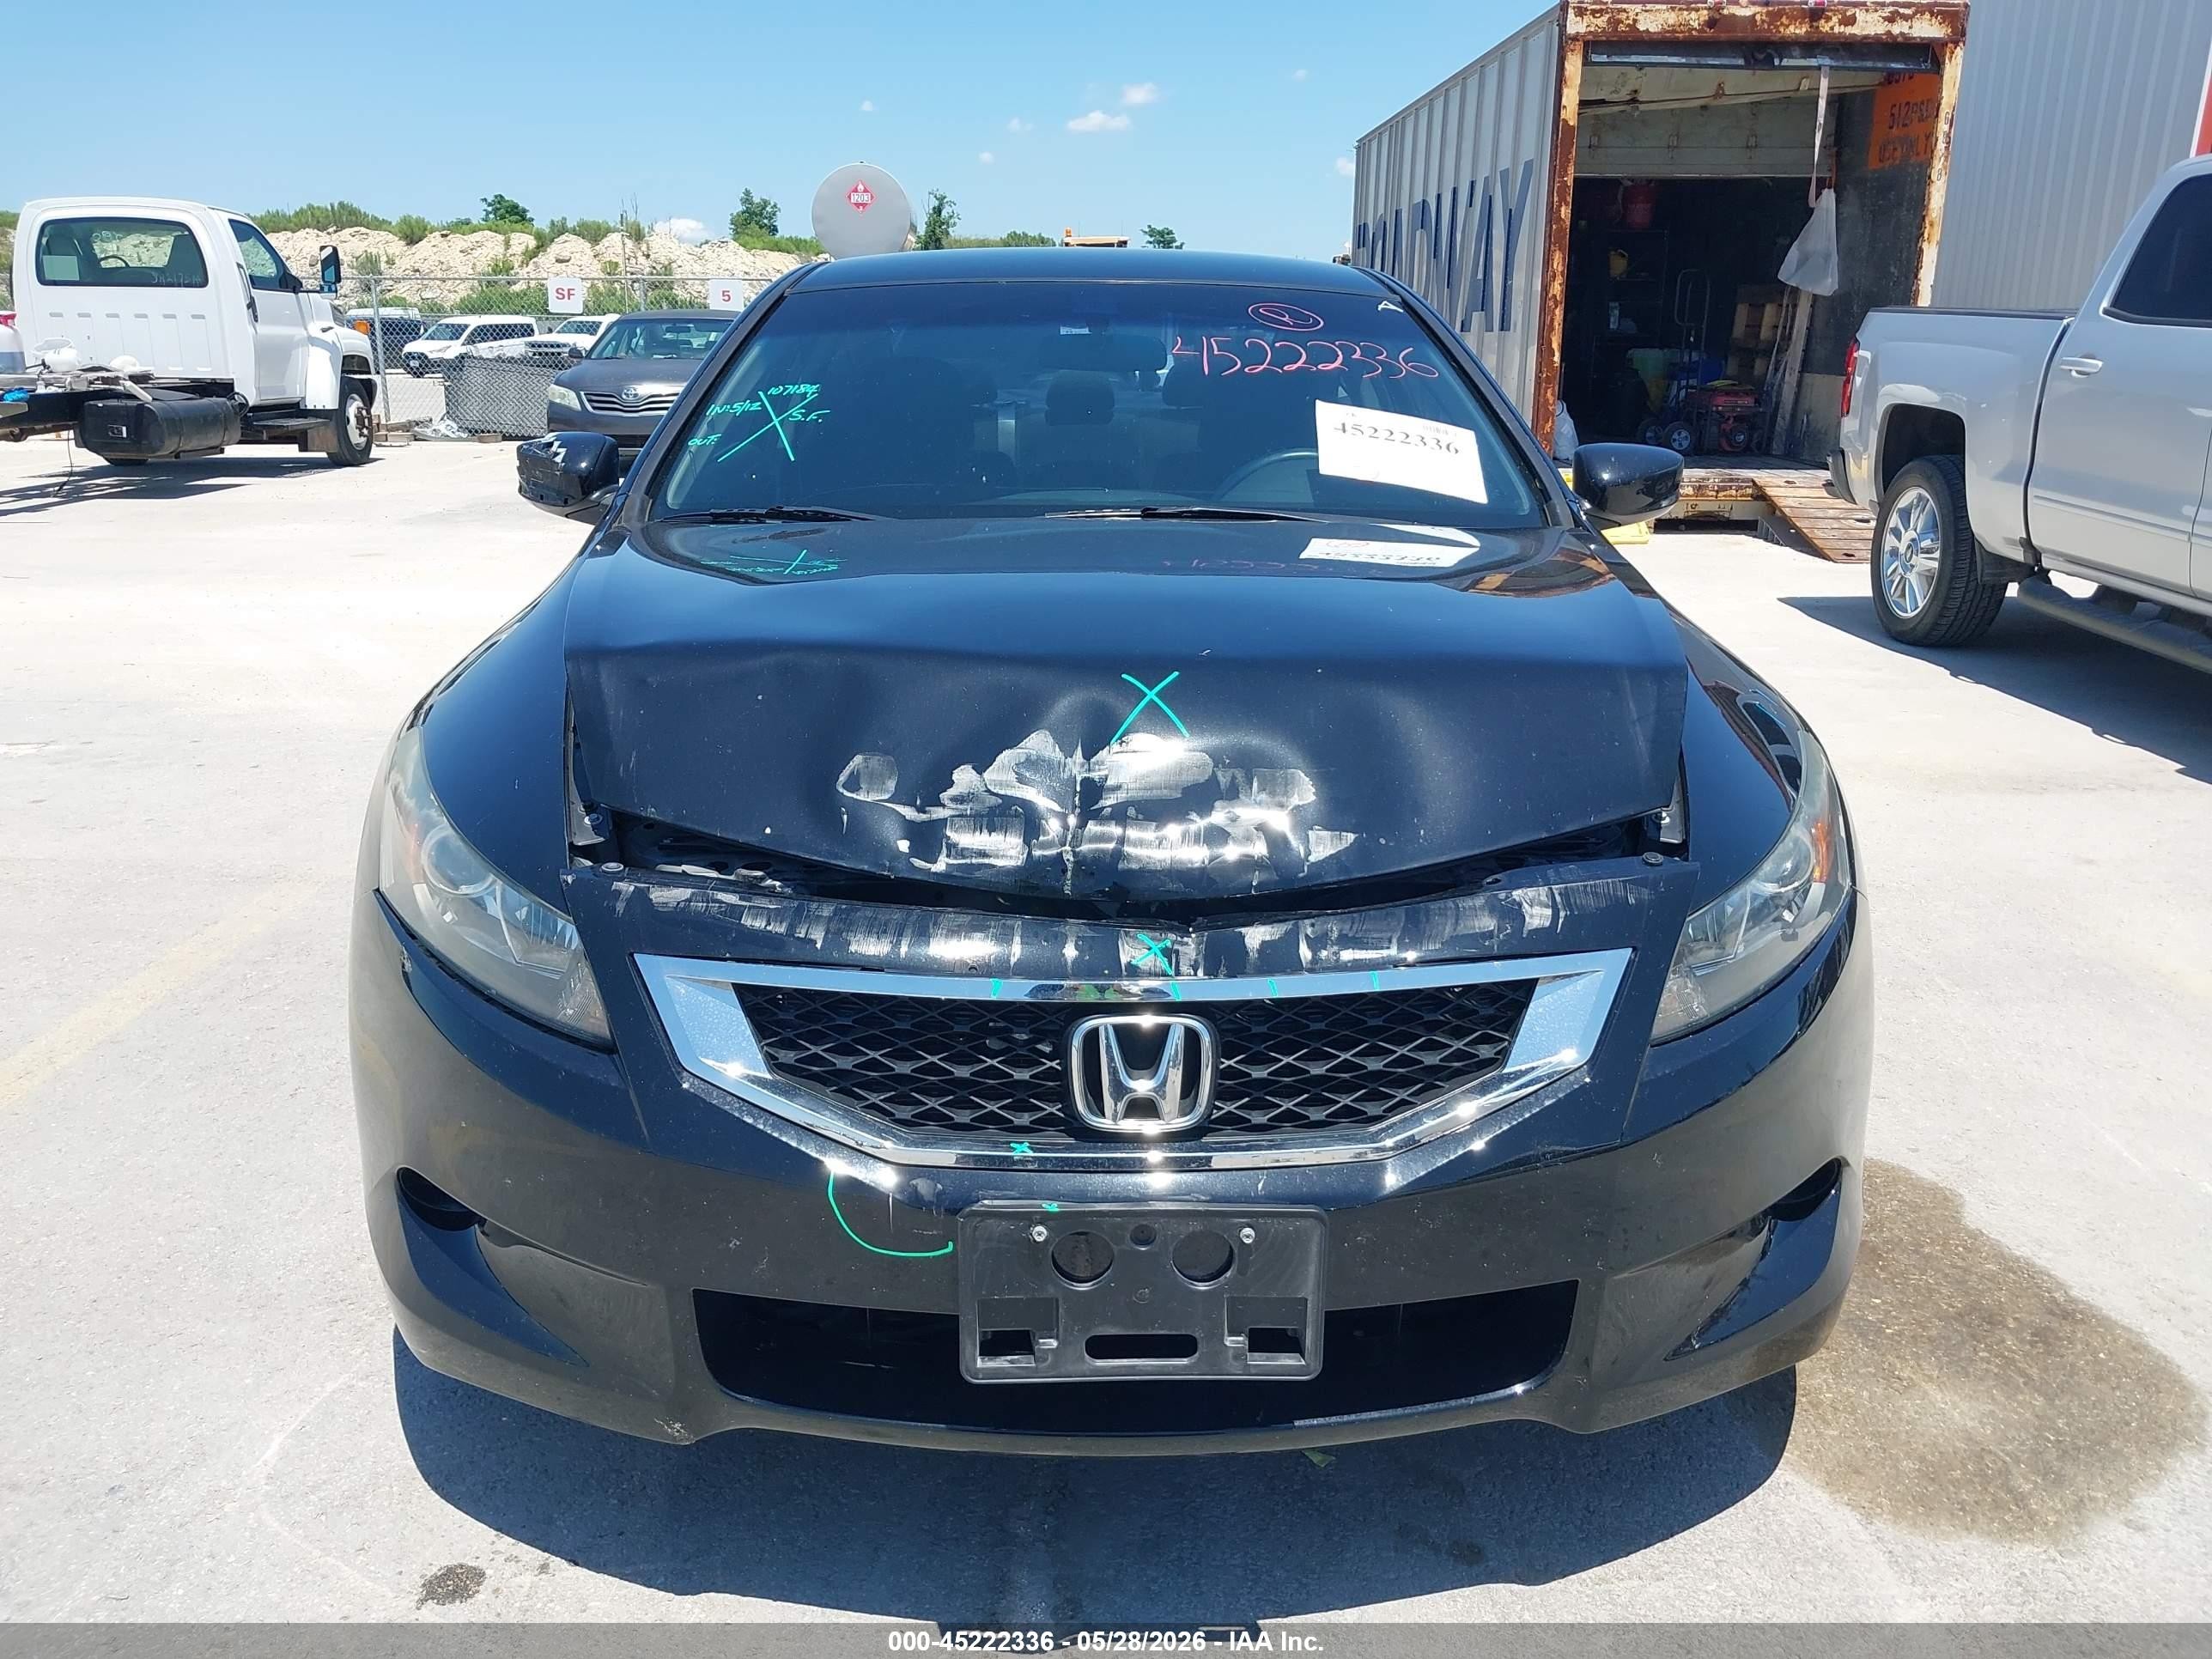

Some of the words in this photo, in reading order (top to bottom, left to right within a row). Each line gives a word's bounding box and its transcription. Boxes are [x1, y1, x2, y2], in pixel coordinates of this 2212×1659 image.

[852, 193, 870, 203] 1203
[555, 288, 576, 301] SF
[720, 290, 732, 302] 5
[1171, 335, 1439, 379] 45222336
